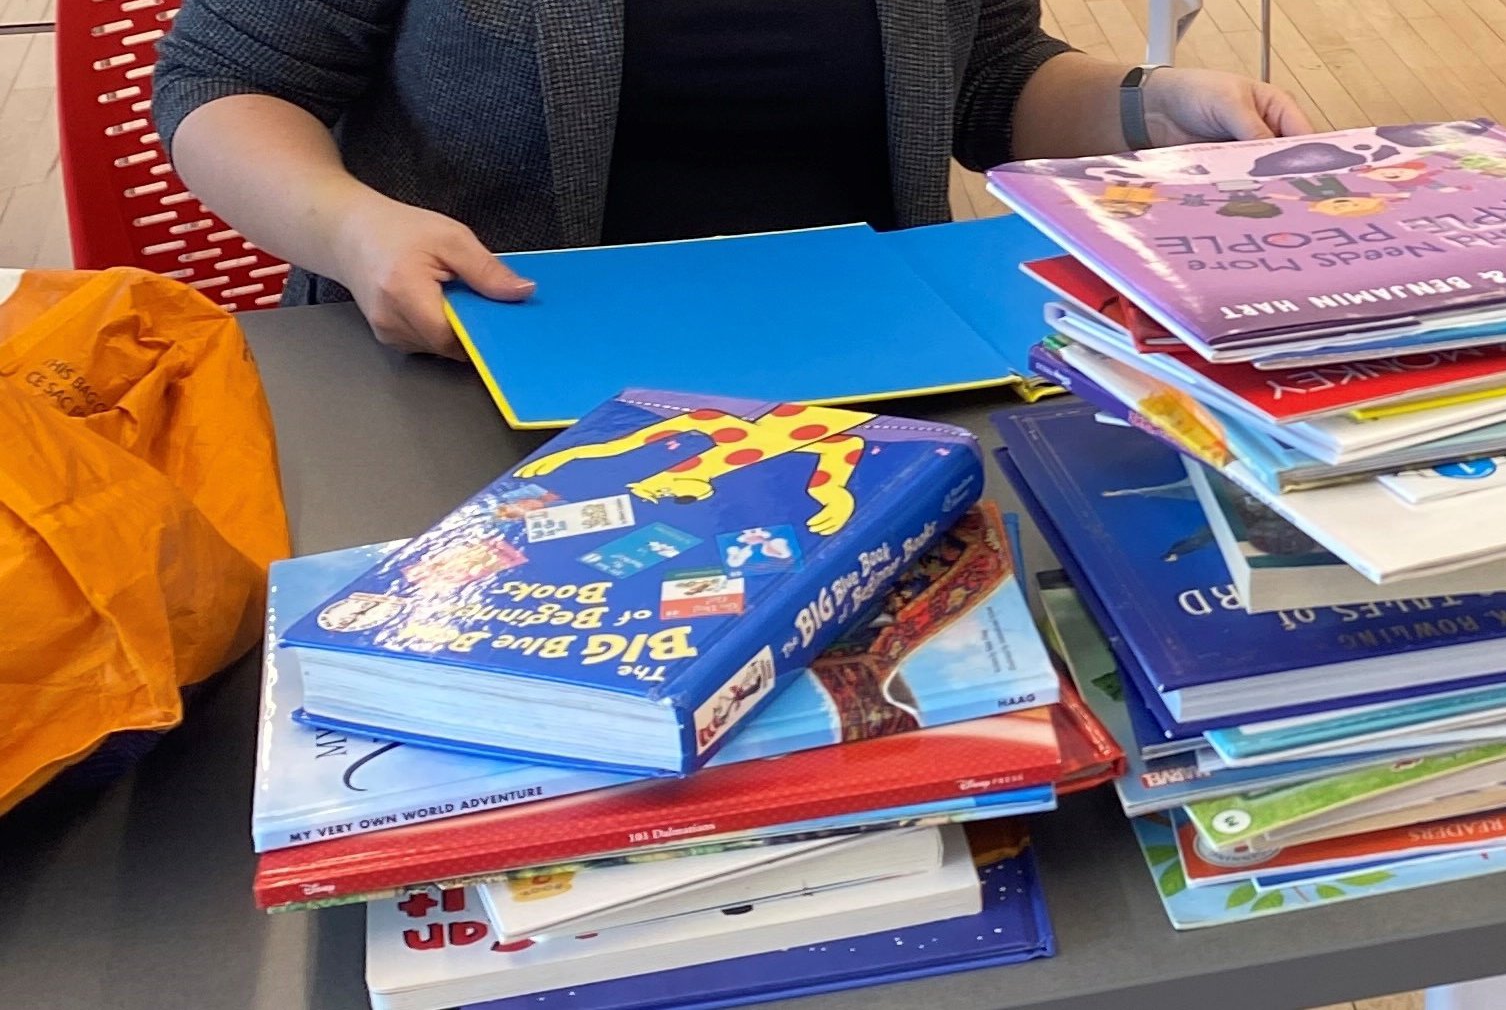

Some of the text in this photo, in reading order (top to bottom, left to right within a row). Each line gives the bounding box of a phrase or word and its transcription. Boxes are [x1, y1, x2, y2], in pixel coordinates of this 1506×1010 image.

[1154, 222, 1397, 255] PEOPLE
[1187, 256, 1304, 274] More
[1312, 241, 1446, 268] Needs
[1307, 276, 1472, 309] BENJAMIN
[1219, 299, 1300, 320] HART
[25, 371, 48, 387] CE
[43, 382, 74, 409] SAC
[72, 376, 98, 404] BAG
[491, 580, 613, 604] Books
[613, 610, 652, 627] of
[794, 586, 836, 649] BIG
[831, 570, 861, 607] Blue
[580, 625, 698, 665] BIG
[1338, 616, 1480, 647] ROWLING
[490, 633, 577, 659] Blue
[617, 664, 666, 682] The
[997, 693, 1036, 708] HAAG
[289, 785, 544, 843] MY VERY OWN WORLD ADVENTURE
[652, 822, 717, 841] Dalmatians
[1408, 818, 1503, 843] READERS
[403, 919, 536, 953] an
